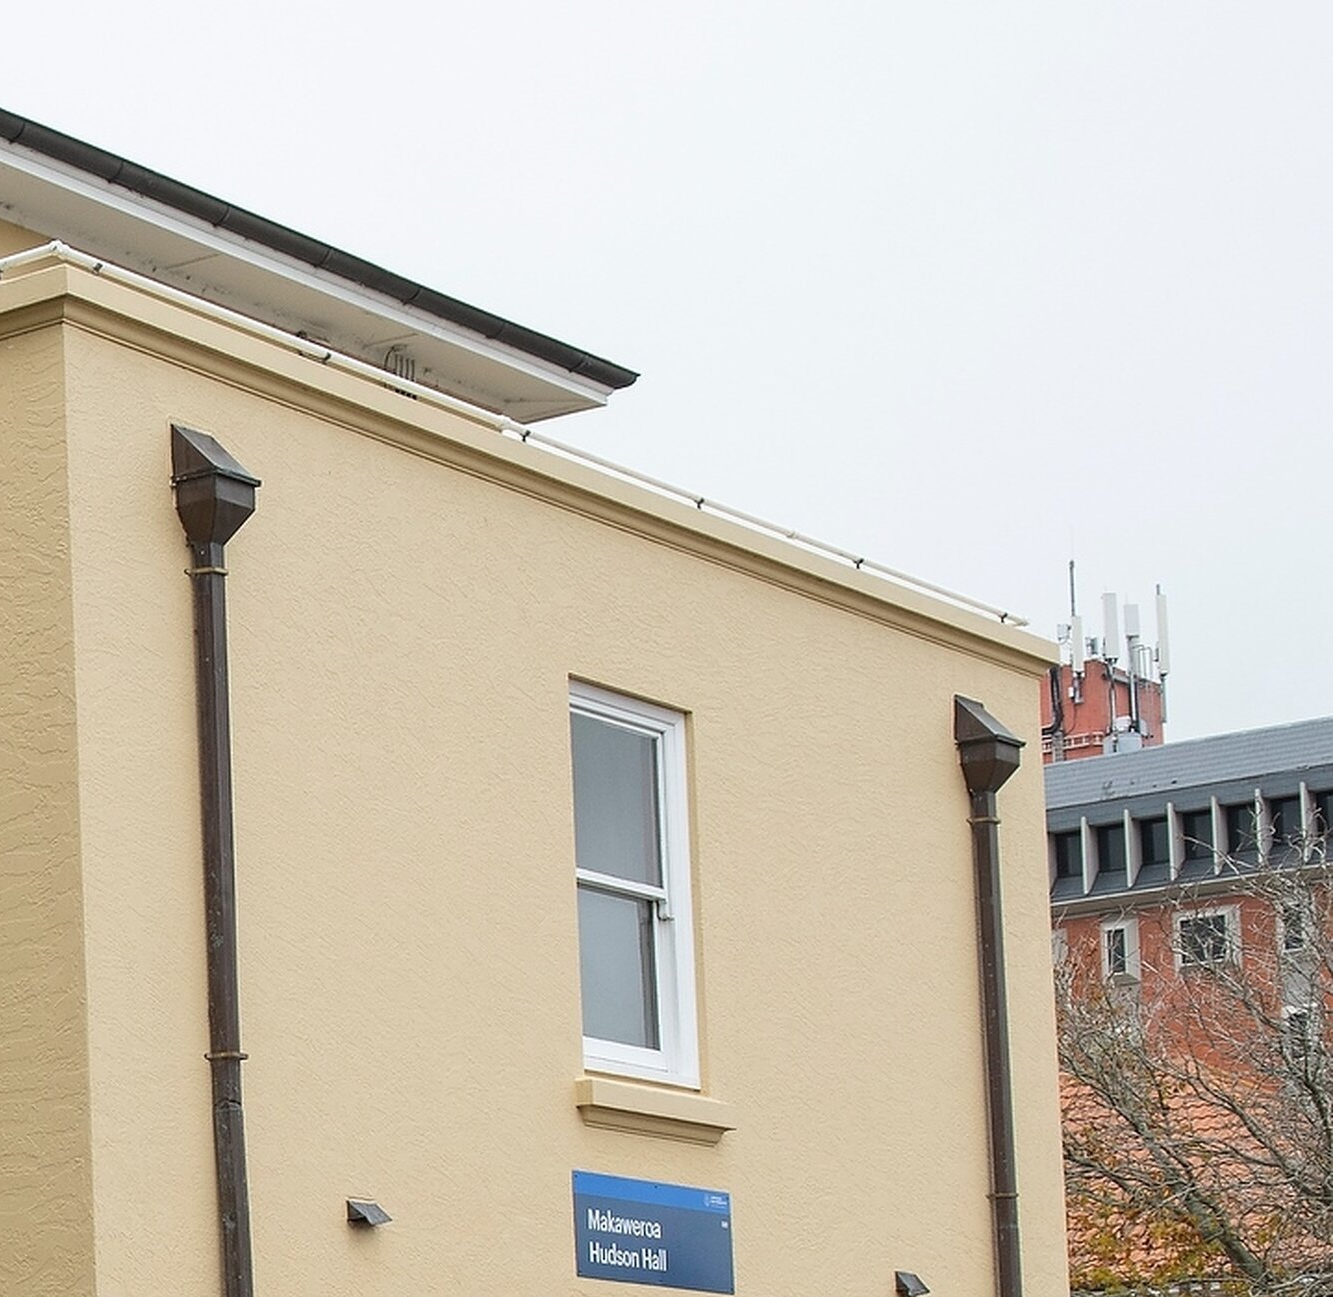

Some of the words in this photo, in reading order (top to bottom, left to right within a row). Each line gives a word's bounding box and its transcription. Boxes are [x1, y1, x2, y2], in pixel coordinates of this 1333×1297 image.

[588, 1208, 661, 1239] Makaweroa
[589, 1241, 639, 1268] Hudson
[642, 1248, 667, 1271] Hall
